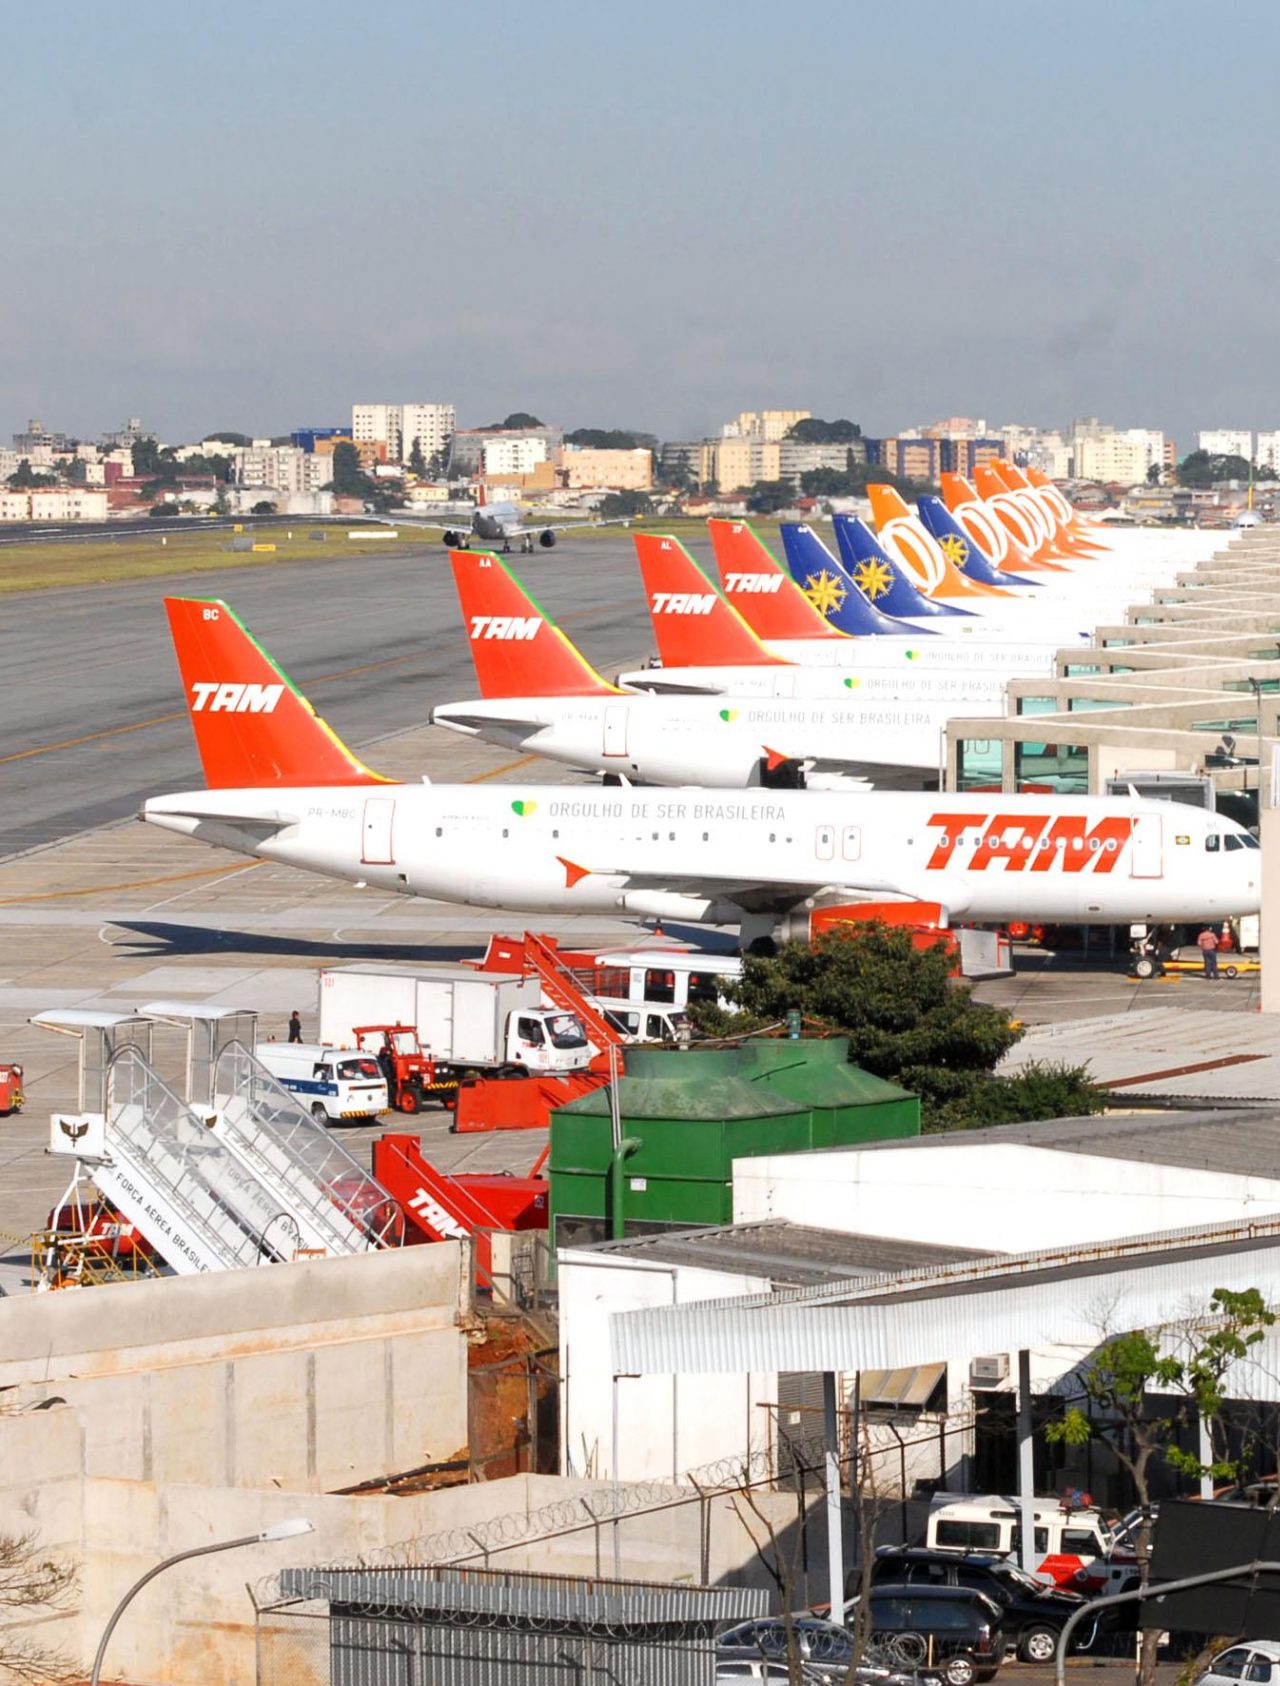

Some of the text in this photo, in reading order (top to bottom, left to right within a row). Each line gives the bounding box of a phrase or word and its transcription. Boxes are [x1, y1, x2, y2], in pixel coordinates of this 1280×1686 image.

[725, 573, 784, 593] TAM
[203, 608, 220, 621] BC
[652, 592, 718, 615] TAM
[470, 615, 544, 640] TAM
[191, 682, 285, 713] TAM
[748, 710, 931, 725] ORGULHO DE SER BRASILEIRA
[549, 802, 786, 820] ORGULHO DE SER BRASILEIRA
[925, 813, 1140, 874] TAM
[407, 1187, 473, 1240] TAM
